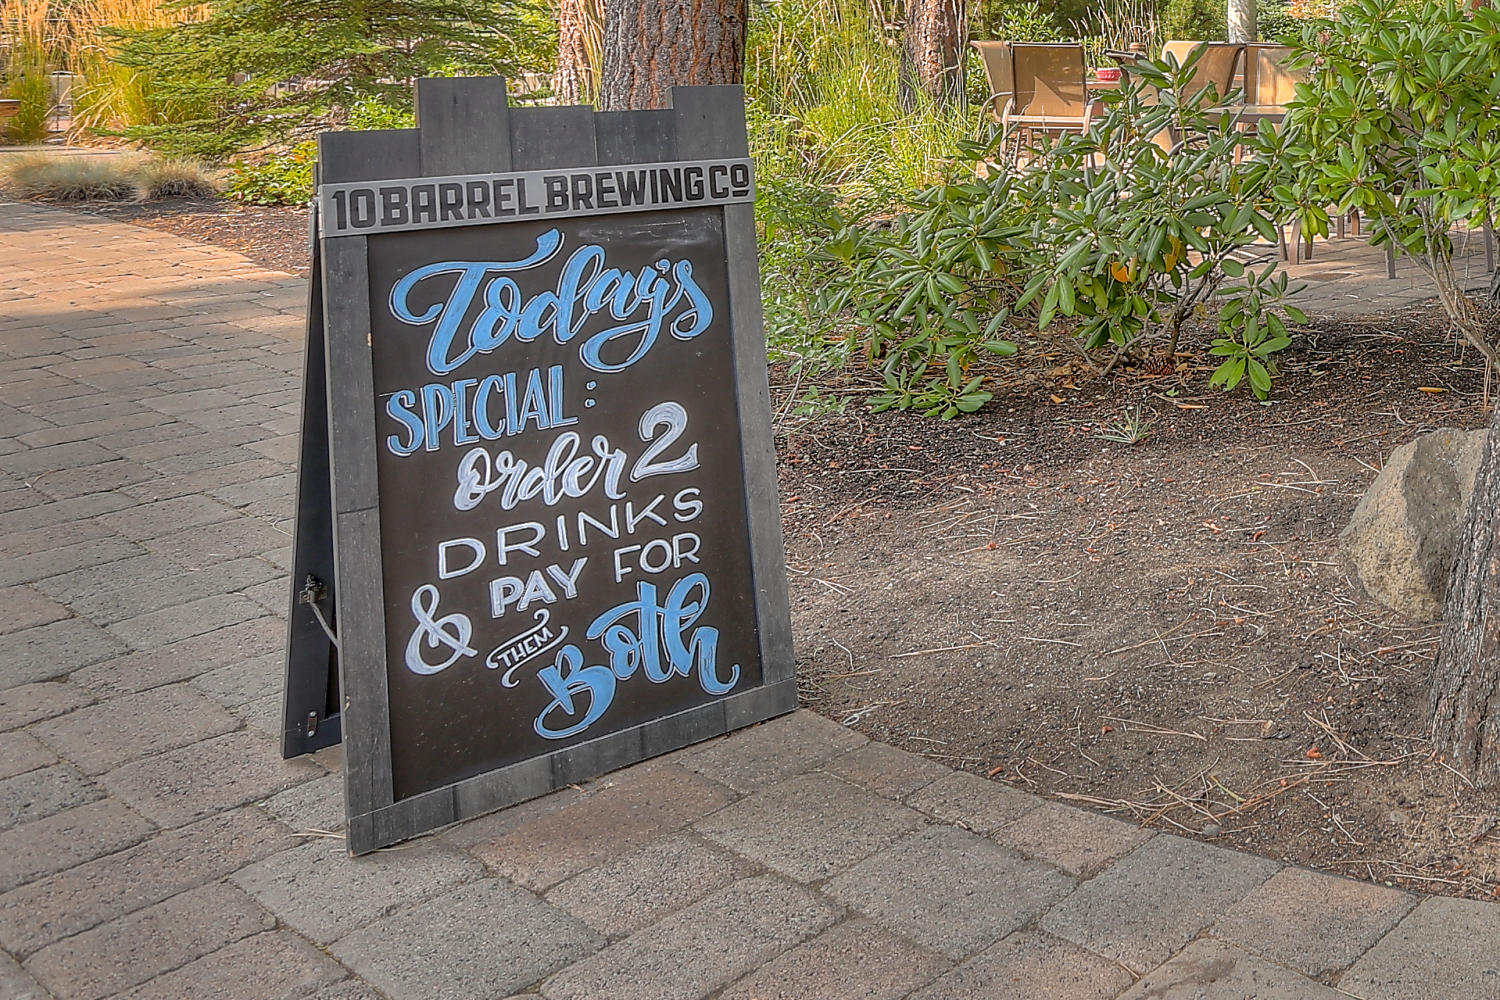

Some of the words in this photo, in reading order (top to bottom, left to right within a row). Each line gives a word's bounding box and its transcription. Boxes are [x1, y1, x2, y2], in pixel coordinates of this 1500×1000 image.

[331, 188, 377, 231] 10
[379, 176, 540, 227] BARREL
[542, 165, 704, 213] BREWING
[388, 227, 714, 376] Today's
[629, 401, 701, 484] 2
[438, 487, 704, 580] DRINKS
[404, 583, 479, 676] &
[488, 556, 589, 619] PAY
[613, 532, 702, 584] FOR
[496, 626, 555, 669] THEM
[533, 572, 741, 740] Both
